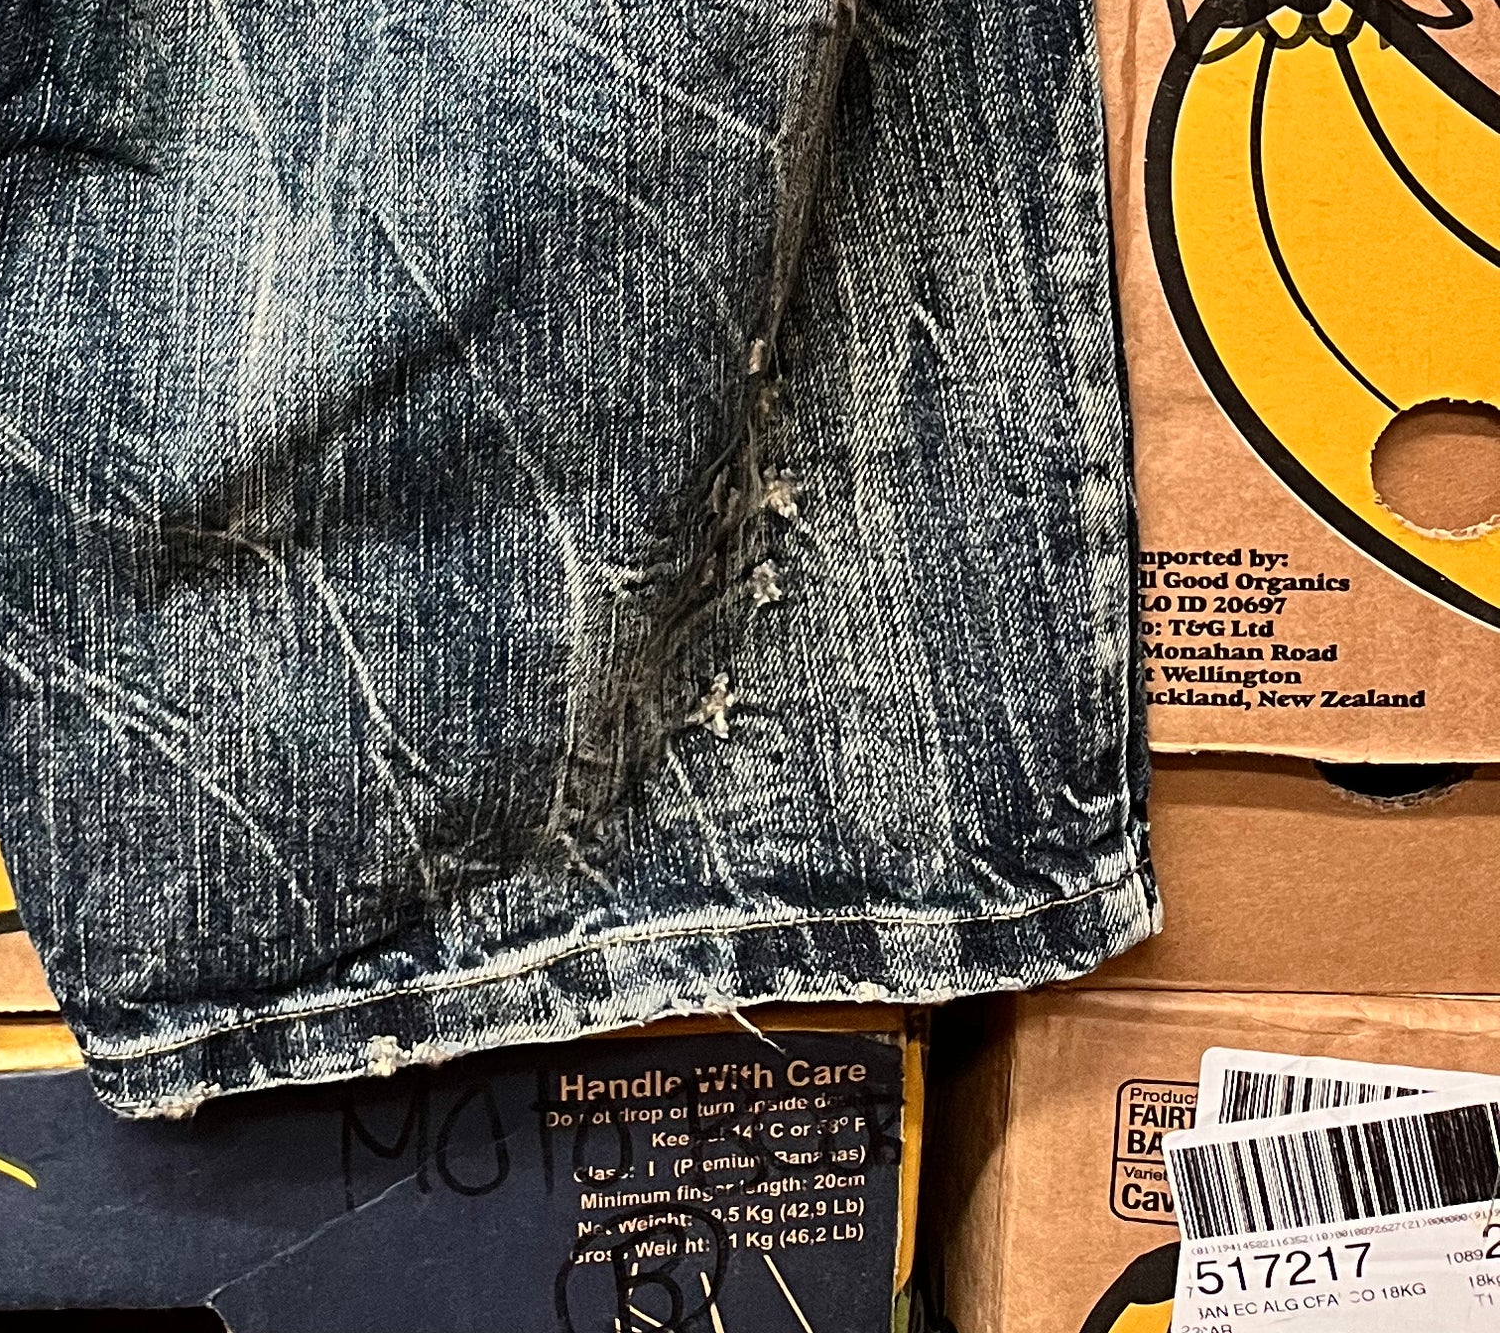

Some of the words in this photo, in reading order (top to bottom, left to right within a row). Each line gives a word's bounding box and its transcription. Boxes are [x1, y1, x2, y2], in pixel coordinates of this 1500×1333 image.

[1249, 548, 1289, 572] by:
[1163, 571, 1229, 590] Good
[1235, 572, 1351, 595] Organics
[1177, 595, 1207, 614] ID
[1213, 596, 1288, 615] 20697
[1168, 619, 1225, 637] T&G
[1231, 619, 1275, 638] Ltd
[1141, 641, 1265, 661] Monahan
[1271, 643, 1338, 662] Road
[1162, 665, 1302, 689] Wellington
[1257, 690, 1316, 708] New
[1320, 688, 1426, 709] Zealand
[560, 1070, 682, 1102] Handle
[787, 1059, 867, 1087] Care
[546, 1111, 573, 1127] Do
[697, 1101, 735, 1117] turn
[769, 1122, 784, 1139] C
[790, 1124, 811, 1137] or
[854, 1116, 866, 1133] F
[580, 1189, 671, 1210] Minimum
[813, 1173, 865, 1190] 20cm
[746, 1204, 774, 1224] Kg
[780, 1200, 827, 1220] (42,9
[833, 1196, 865, 1216] Lb)
[746, 1230, 774, 1251] Kg
[779, 1226, 827, 1248] (46,2
[833, 1222, 865, 1242] Lb)
[1196, 1242, 1372, 1296] 517217
[1446, 1248, 1484, 1266] 1089
[1233, 1301, 1258, 1317] EC
[1263, 1295, 1299, 1315] ALG
[1381, 1281, 1427, 1300] 18KG
